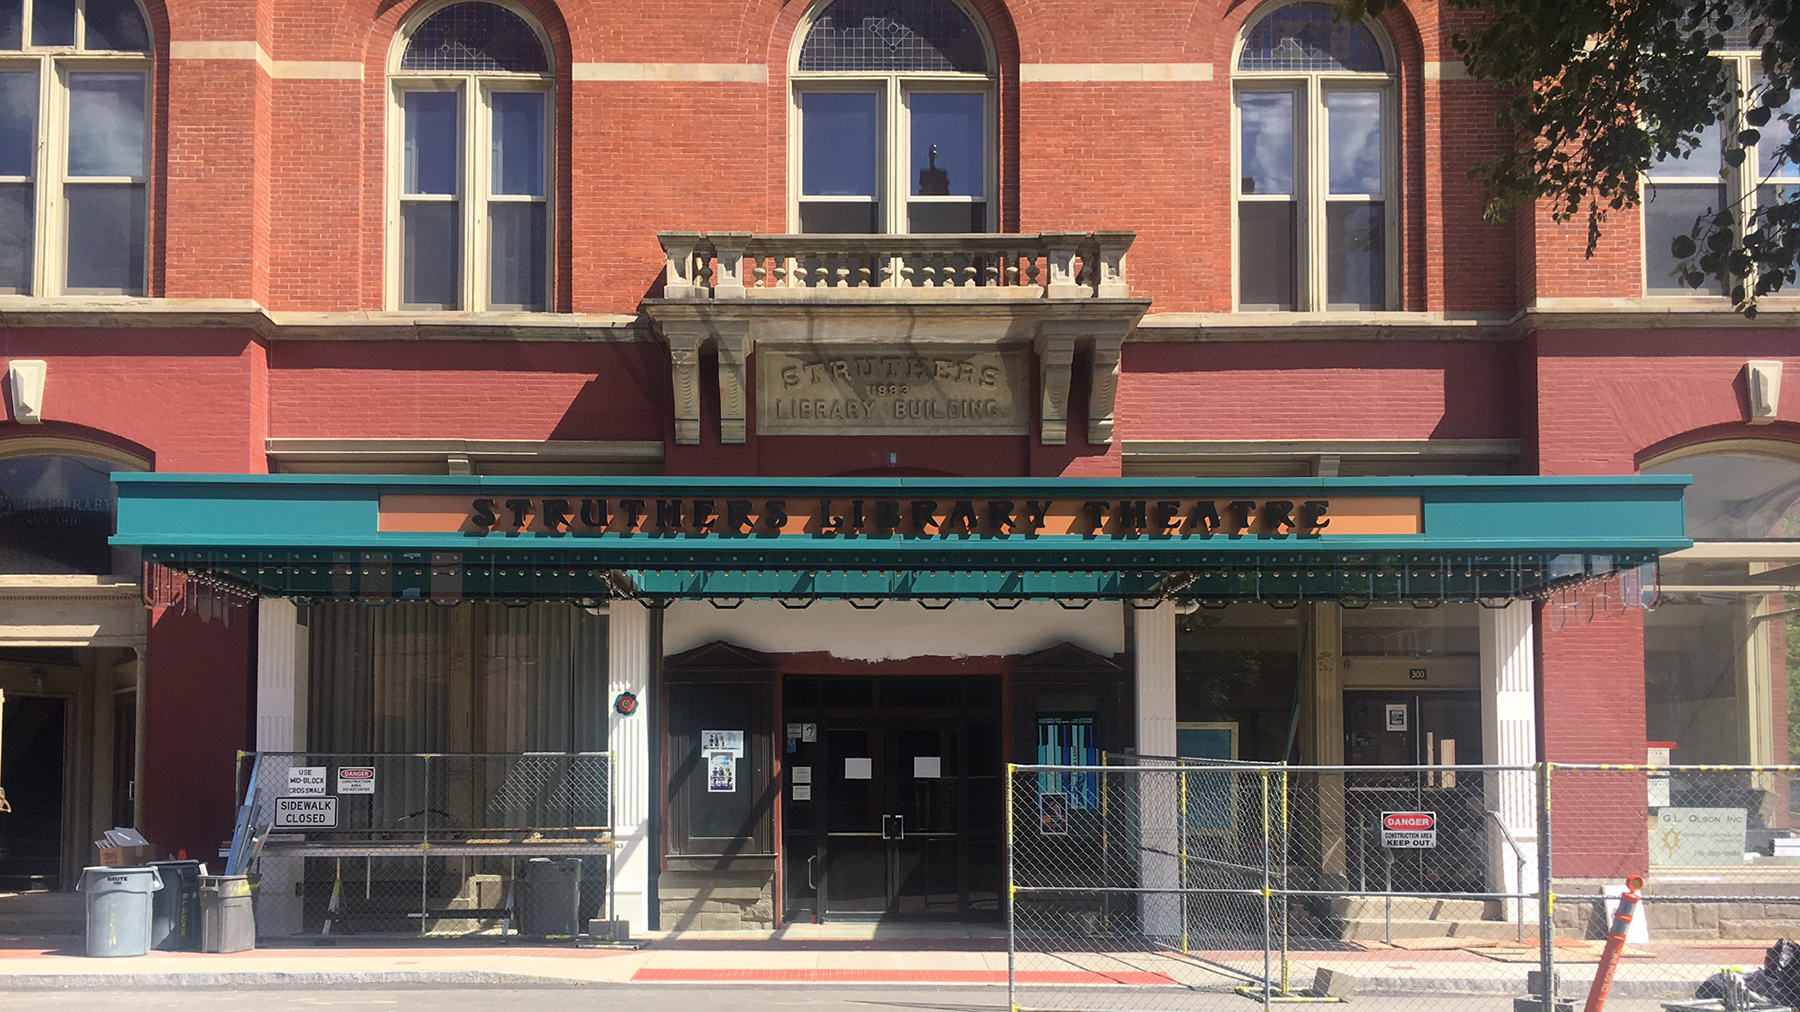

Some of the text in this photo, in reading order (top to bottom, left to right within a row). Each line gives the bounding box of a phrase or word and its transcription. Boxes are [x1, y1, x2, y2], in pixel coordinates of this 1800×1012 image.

[781, 356, 999, 390] STRUTHERS
[867, 384, 909, 397] 1883
[776, 400, 876, 420] LIBRARY
[472, 499, 1330, 529] STRUTHERS LIBRARY THEATRE
[281, 801, 331, 810] SIDEWALK
[286, 814, 325, 823] CLOSED
